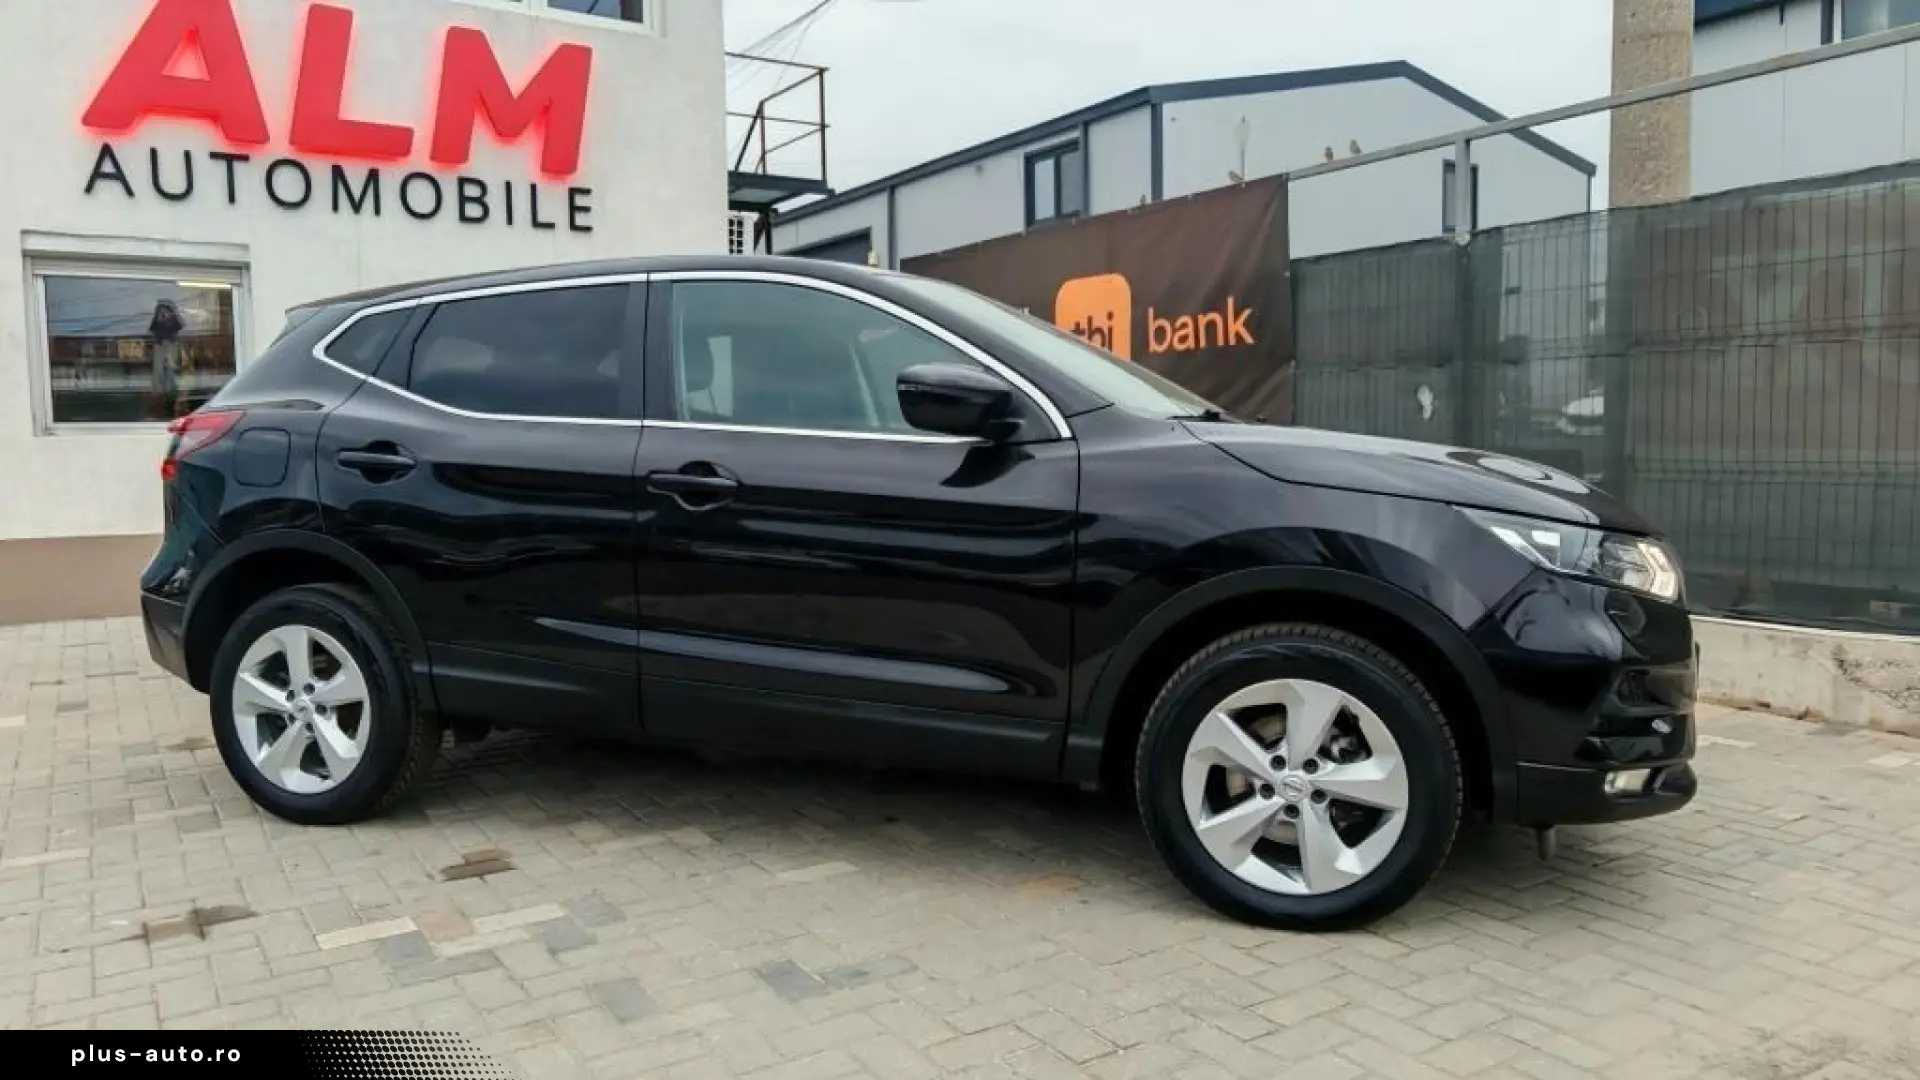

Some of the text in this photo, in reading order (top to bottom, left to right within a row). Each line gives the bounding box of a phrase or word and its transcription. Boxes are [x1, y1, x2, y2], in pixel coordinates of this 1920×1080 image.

[81, 0, 593, 176] ALM
[84, 142, 594, 232] AUTOMOBILE
[1148, 296, 1254, 352] bank
